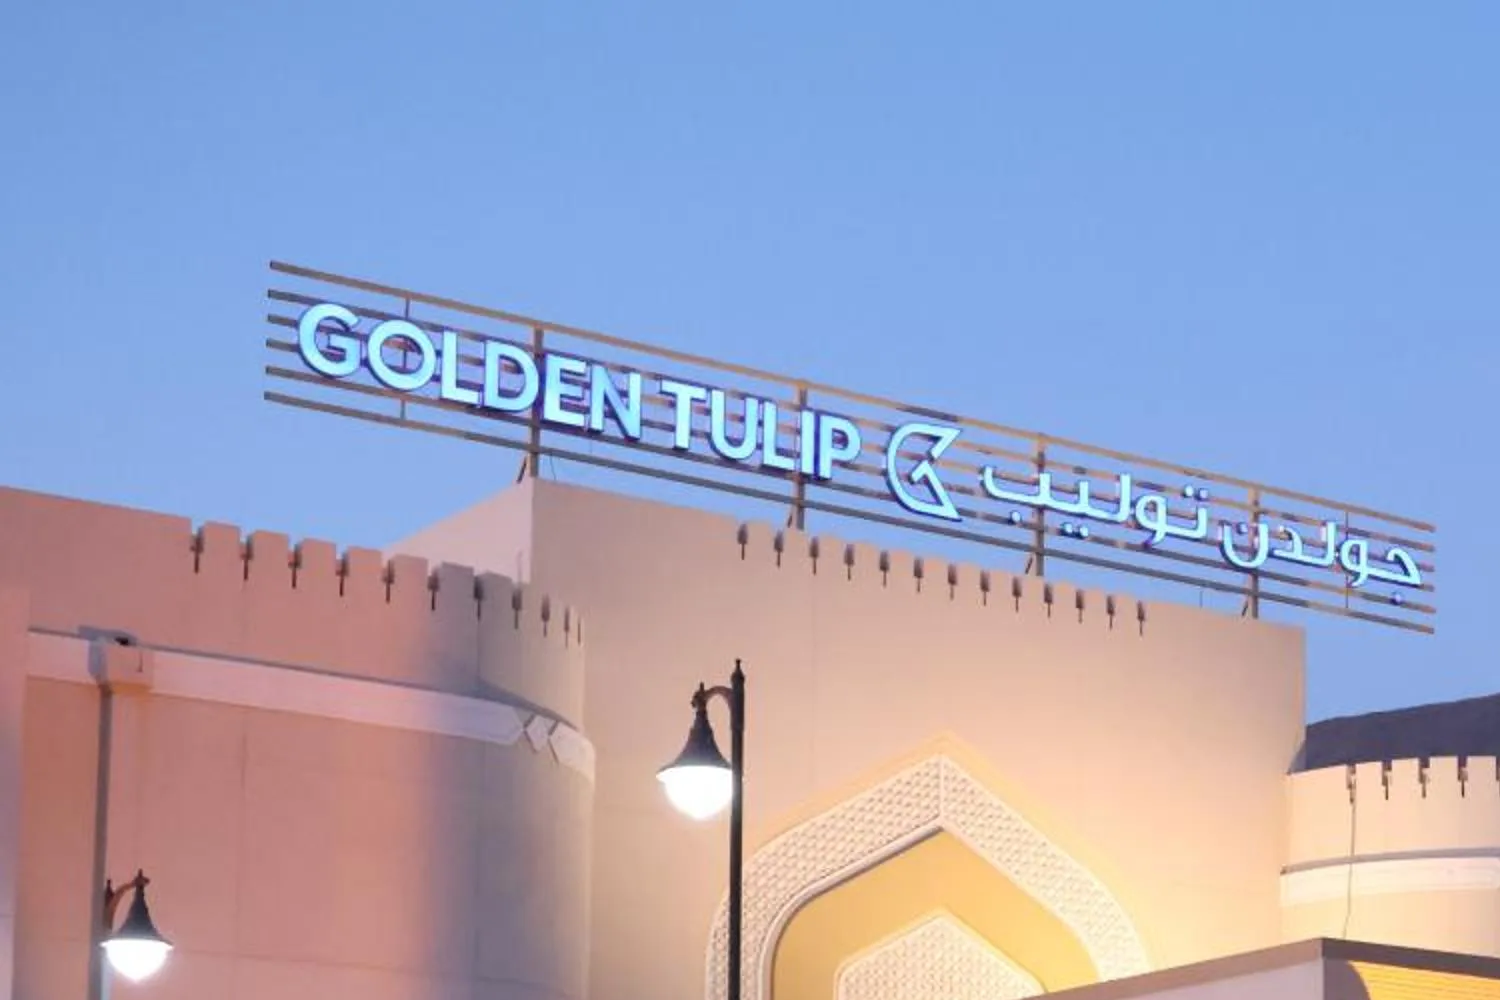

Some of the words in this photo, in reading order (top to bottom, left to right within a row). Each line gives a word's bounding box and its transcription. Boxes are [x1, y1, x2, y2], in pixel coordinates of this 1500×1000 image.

[298, 302, 643, 441] GOLDEN
[659, 380, 862, 481] TULIP
[979, 465, 1210, 548] توليب
[1219, 519, 1423, 606] جولدن
